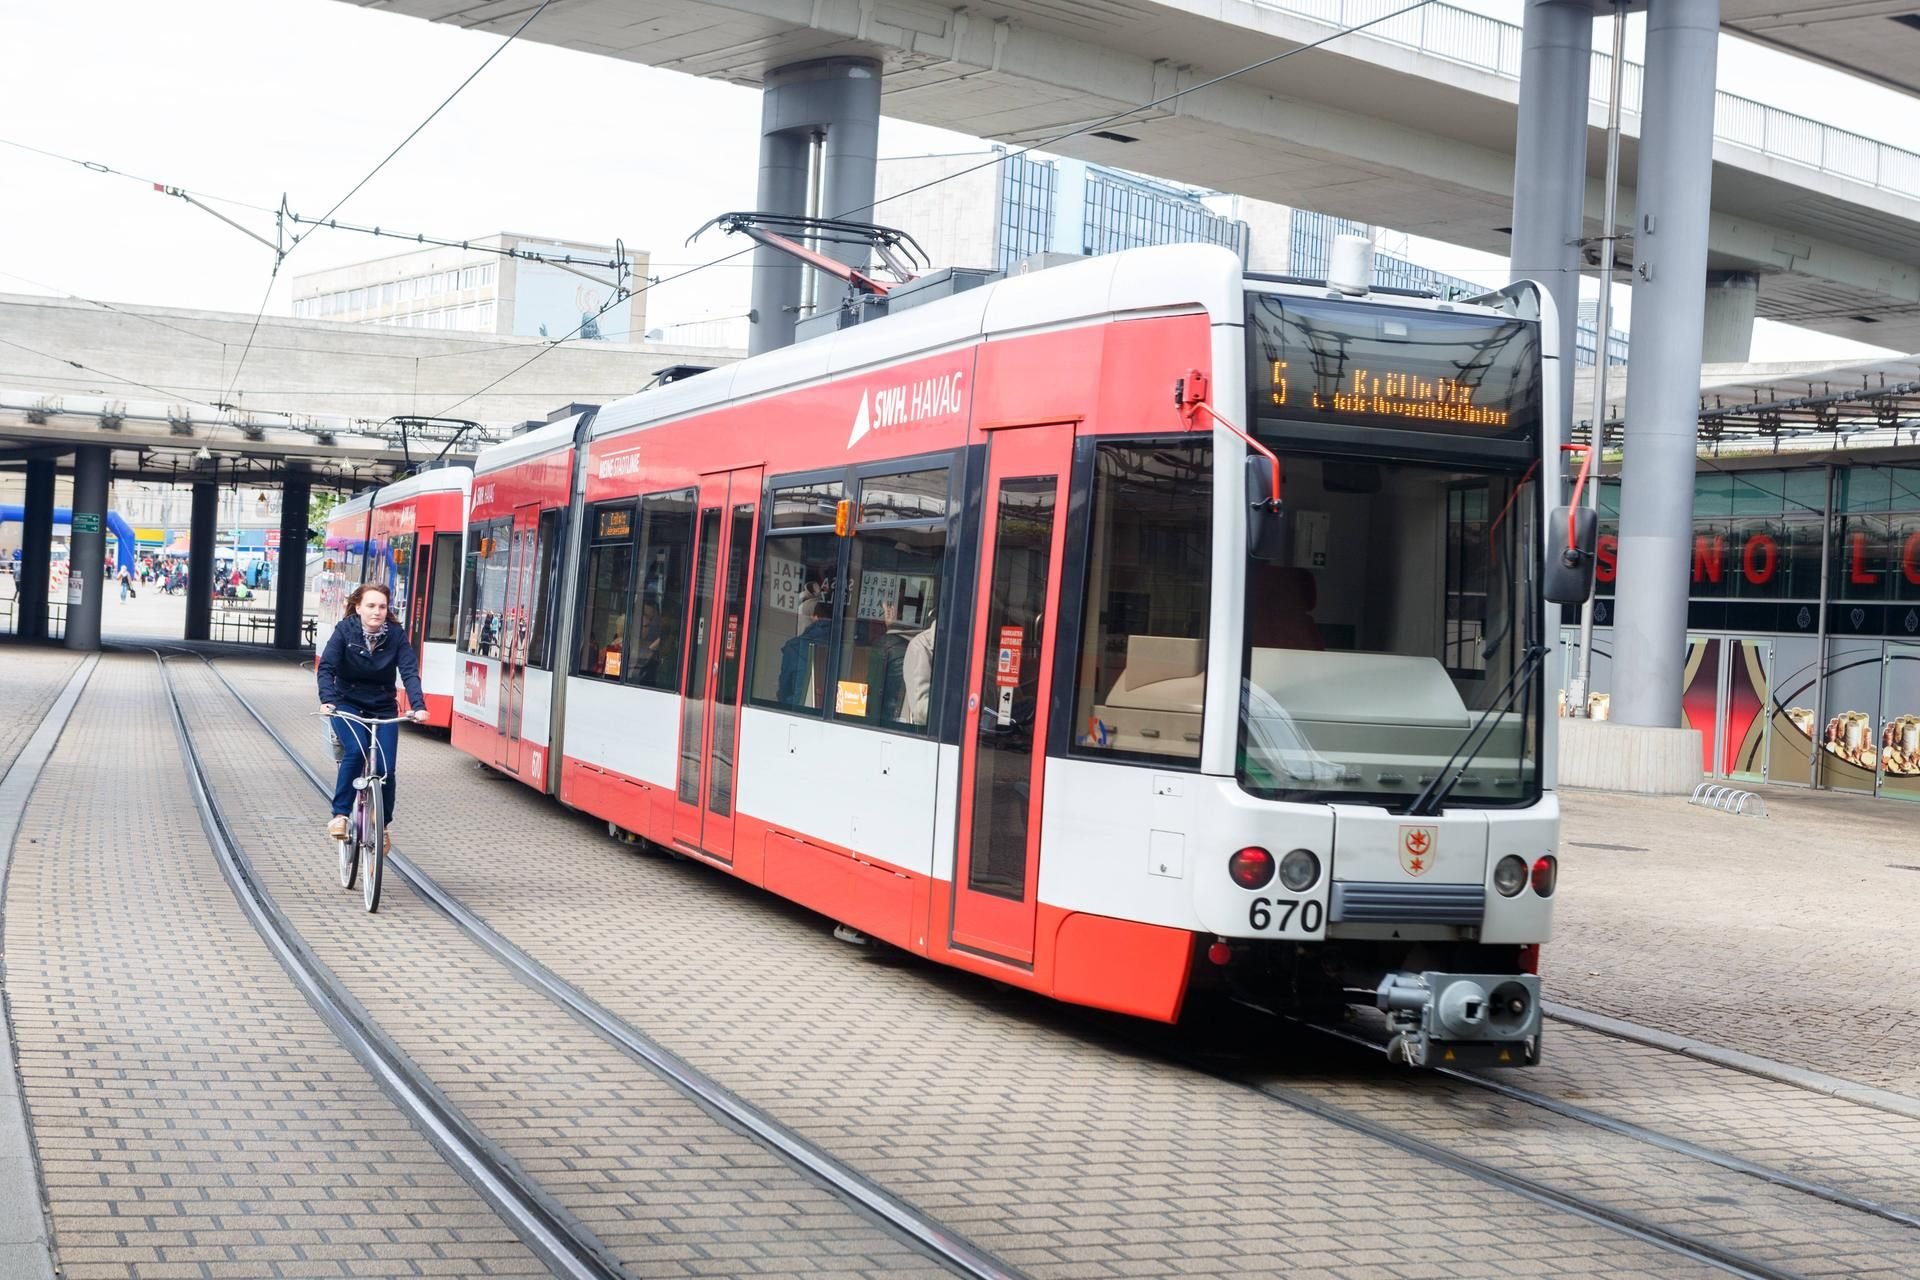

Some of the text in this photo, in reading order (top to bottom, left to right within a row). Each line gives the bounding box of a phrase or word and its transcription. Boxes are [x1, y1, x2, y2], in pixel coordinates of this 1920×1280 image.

[911, 371, 963, 422] HAVAG
[1271, 360, 1288, 405] 5
[1595, 533, 1777, 584] SNO
[1249, 897, 1323, 934] 670
